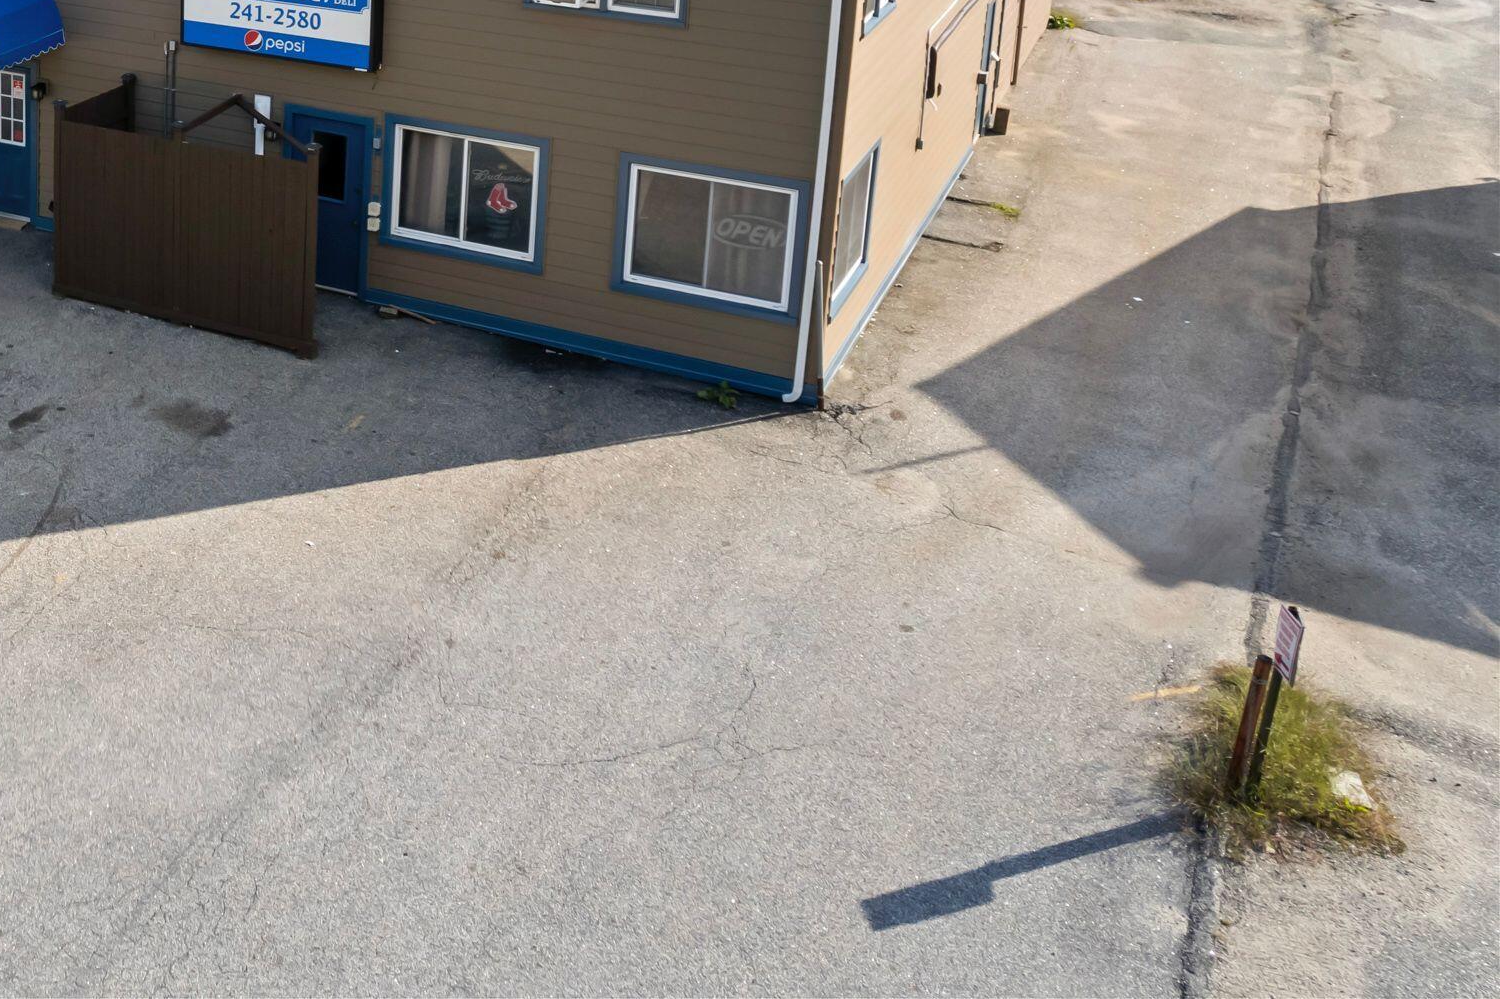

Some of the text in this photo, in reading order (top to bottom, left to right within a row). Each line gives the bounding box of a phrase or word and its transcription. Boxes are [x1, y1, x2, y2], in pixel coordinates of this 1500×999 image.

[230, 2, 321, 30] 241-2580
[265, 38, 306, 54] pepsi
[716, 217, 785, 248] OPEN
